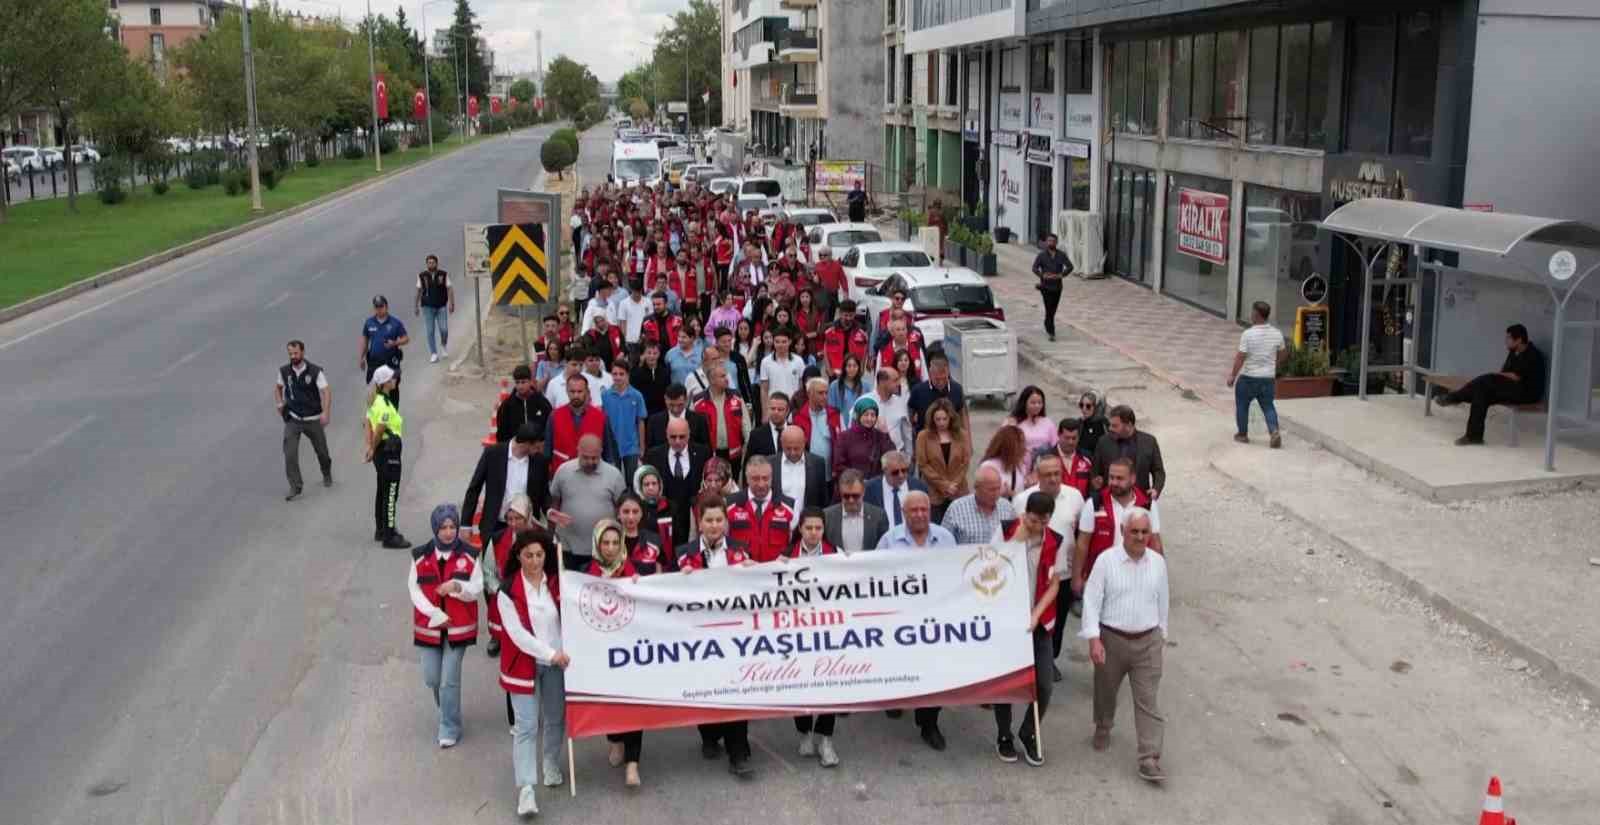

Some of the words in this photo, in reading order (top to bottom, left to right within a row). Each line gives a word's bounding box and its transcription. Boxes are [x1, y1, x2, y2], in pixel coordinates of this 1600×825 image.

[772, 566, 818, 587] T.C.
[817, 573, 929, 601] VALİLİĞİ
[752, 610, 761, 631] 1
[773, 606, 845, 629] Ekim
[608, 637, 725, 669] DÜNYA
[732, 626, 885, 659] YAŞLILAR
[893, 615, 992, 646] GÜNÜ
[734, 657, 801, 683] Kutlu
[812, 654, 873, 677] Olsun
